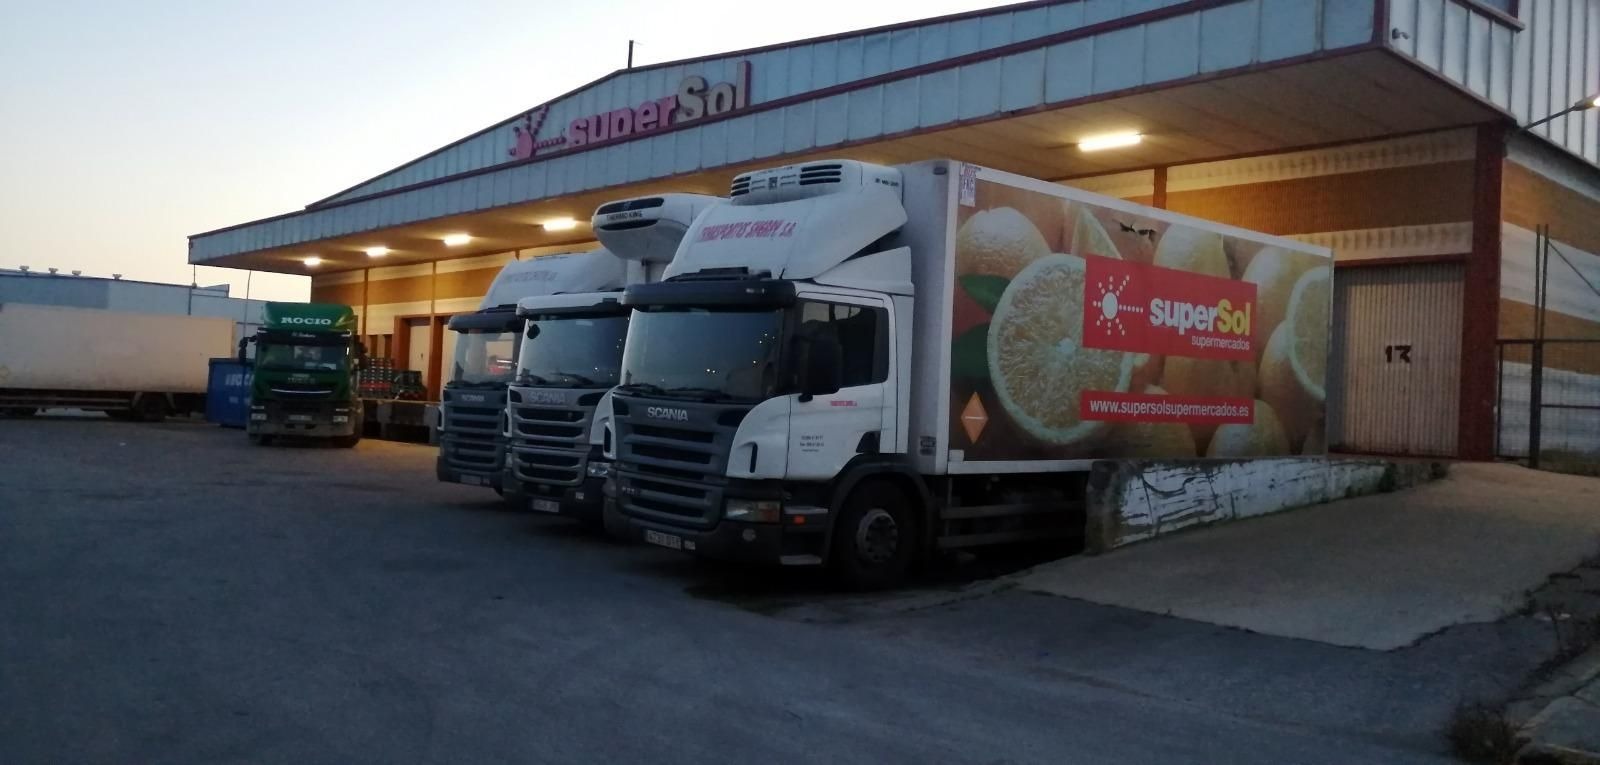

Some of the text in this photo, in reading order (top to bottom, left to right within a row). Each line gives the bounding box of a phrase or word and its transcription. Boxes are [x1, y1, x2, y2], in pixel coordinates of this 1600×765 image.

[568, 60, 752, 147] superSol
[629, 210, 643, 218] KING
[280, 315, 332, 327] ROCIO
[1150, 298, 1251, 336] superSol
[1191, 335, 1250, 351] supermercados
[528, 391, 566, 404] SCANIA
[647, 406, 689, 422] SCANIA
[1090, 399, 1249, 417] www.supersolsupermercados.es
